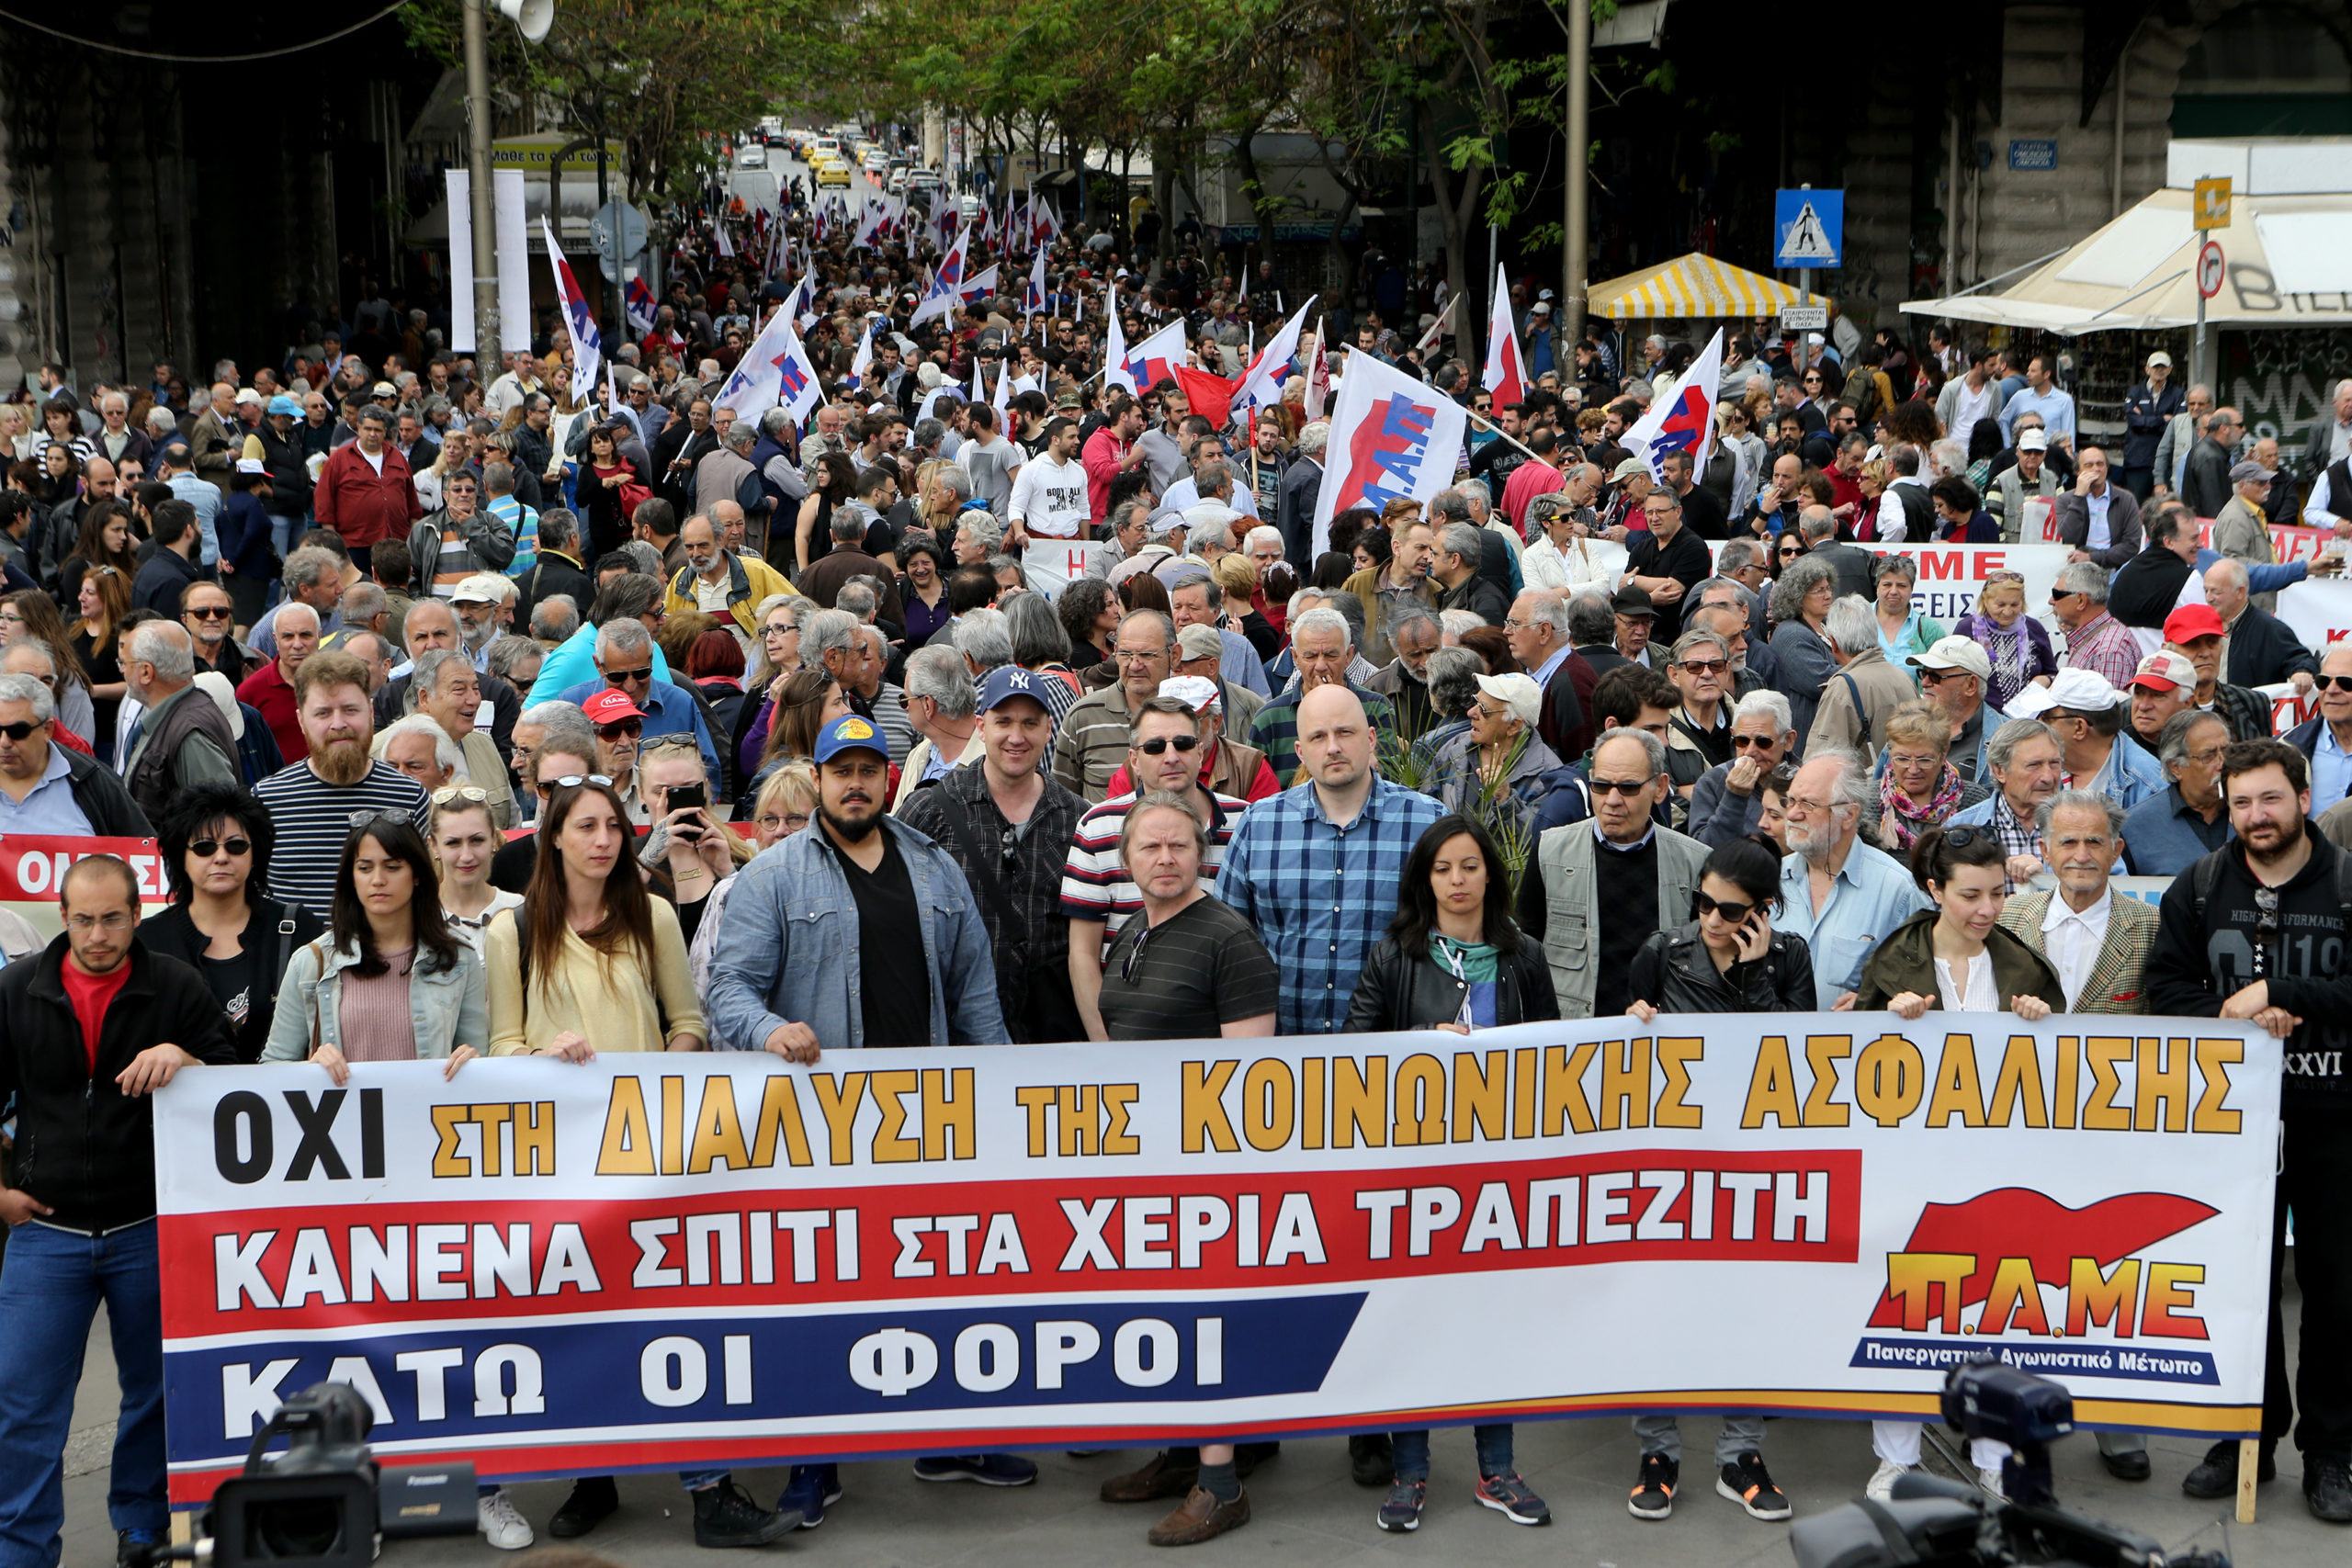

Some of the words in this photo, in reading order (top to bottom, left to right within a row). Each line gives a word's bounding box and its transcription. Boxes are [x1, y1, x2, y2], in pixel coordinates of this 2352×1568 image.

[580, 150, 614, 162] τώα
[2231, 909, 2257, 924] HIGH
[213, 1088, 386, 1184] ΟΧΙ
[430, 1100, 556, 1179] ΣΤΗ
[594, 1067, 976, 1176] ΔΙΑΛΥΣΗ
[1015, 1083, 1140, 1157] ΤΗΣ
[1181, 1036, 1704, 1154] ΚΟΙΝΩΝΙΚΗΣ
[1739, 1032, 2245, 1134] ΑΣΦΑΛΙΣΗΣ
[213, 1222, 603, 1312] ΚΑΝΕΝΑ
[629, 1207, 860, 1288] ΣΠΙΤΙ
[891, 1213, 1030, 1278] ΣΤΑ
[1057, 1192, 1329, 1272] ΧΕΡΙΑ
[1355, 1169, 1829, 1260] ΤΡΑΠΕΖΙΤΗ
[222, 1343, 545, 1439] ΚΑΤΩ
[639, 1334, 753, 1407] ΟΙ
[848, 1315, 1224, 1397] ΦΟΡΟΙ
[1866, 1342, 1994, 1367] Πανεργατιό
[2000, 1347, 2113, 1371] Αγωνιστικό
[2119, 1350, 2203, 1375] Μέτωπο
